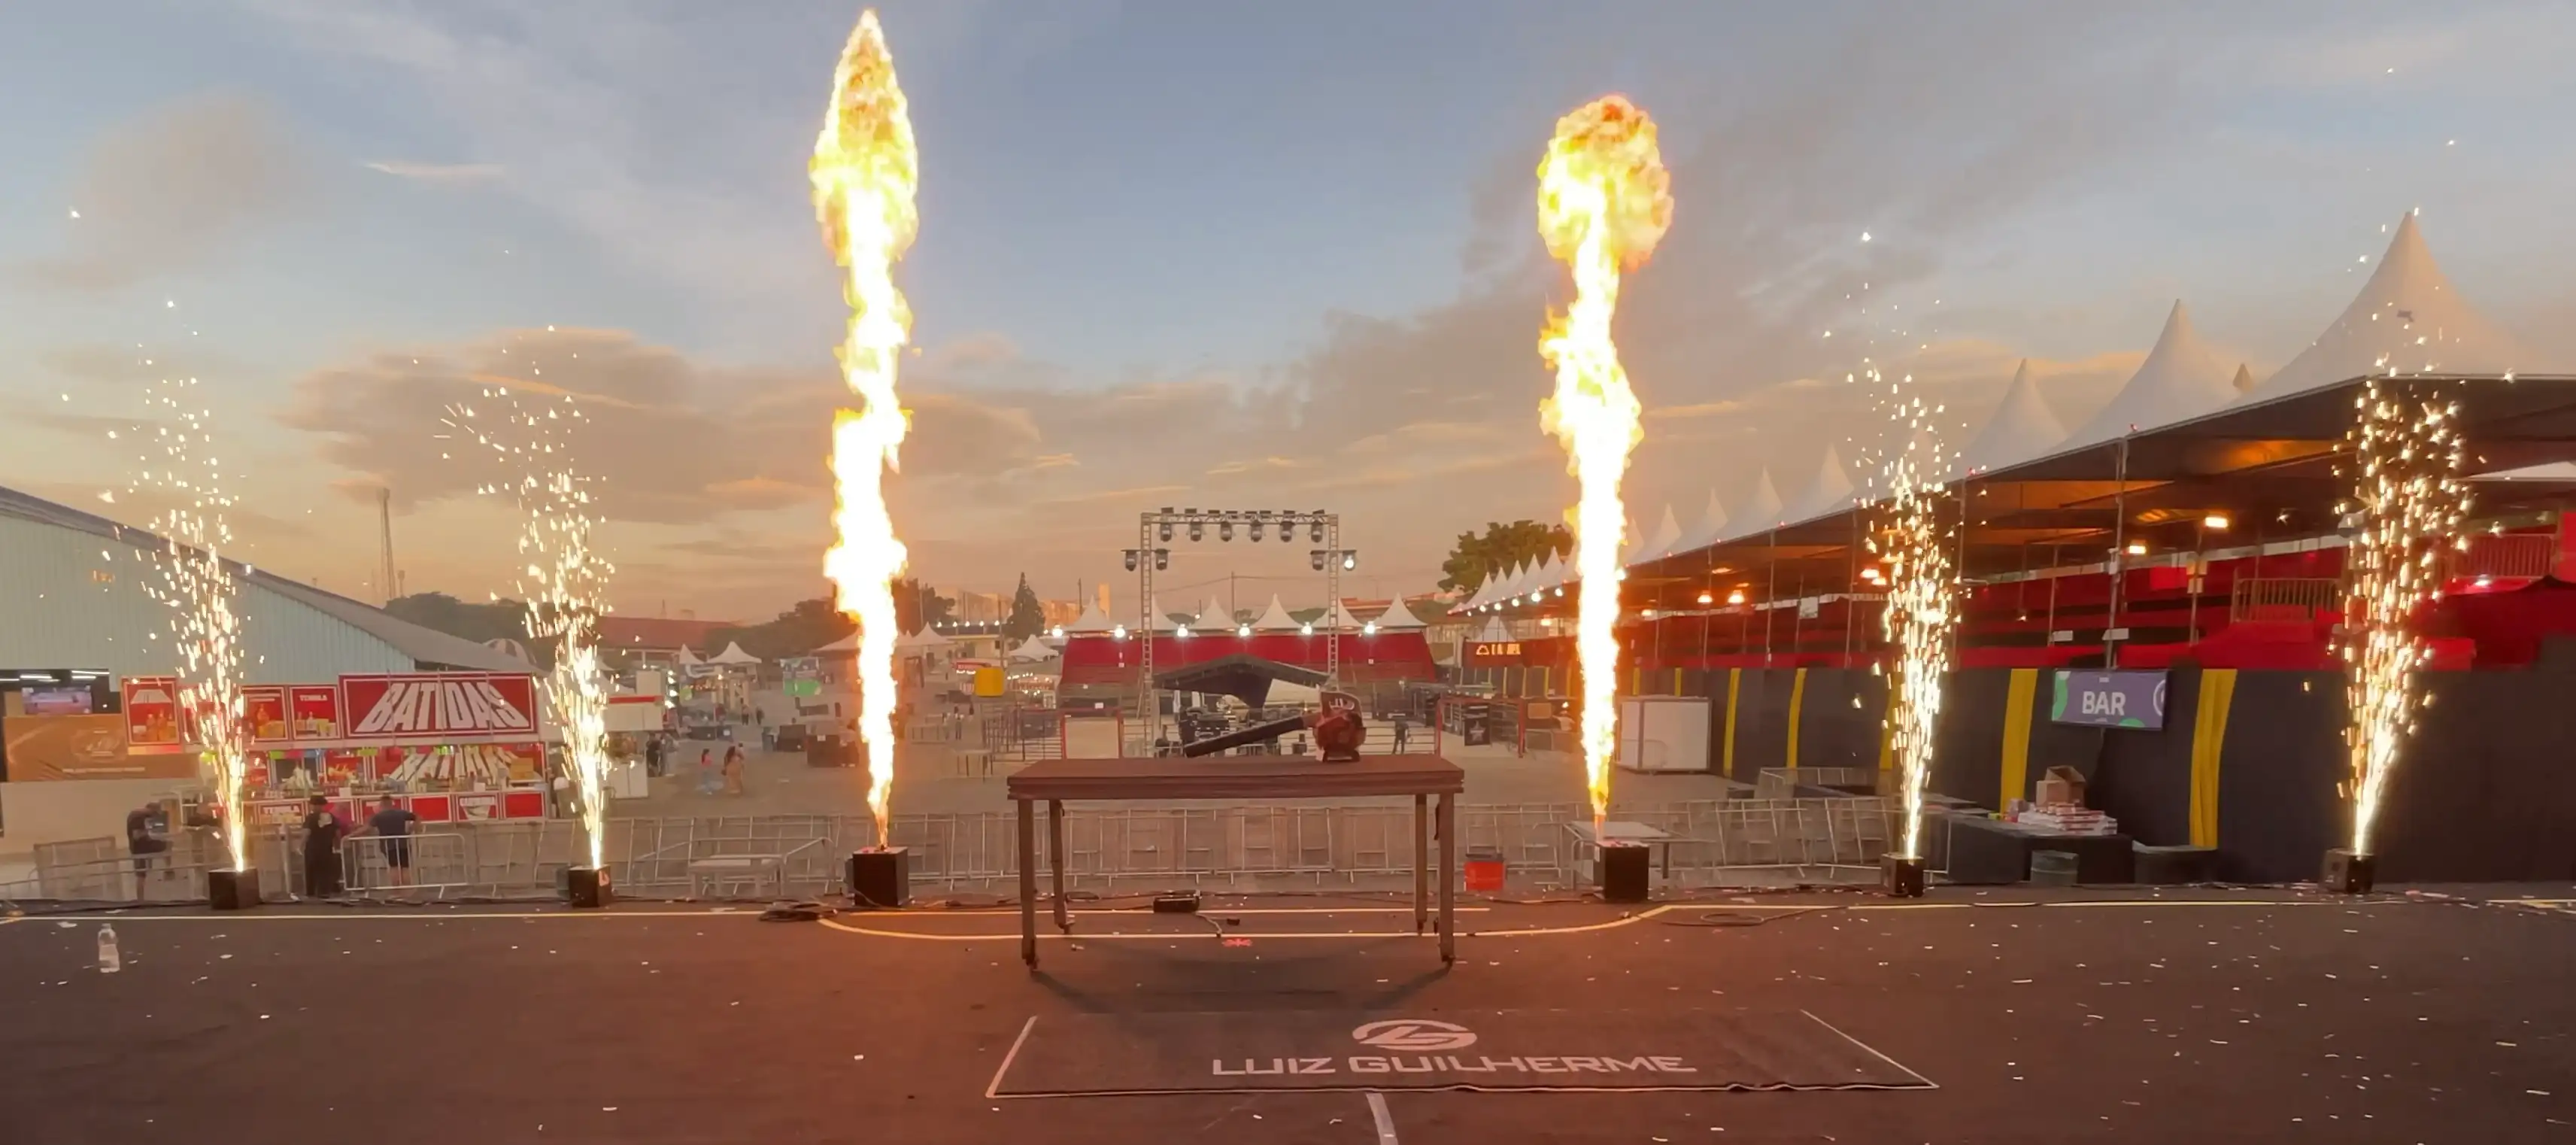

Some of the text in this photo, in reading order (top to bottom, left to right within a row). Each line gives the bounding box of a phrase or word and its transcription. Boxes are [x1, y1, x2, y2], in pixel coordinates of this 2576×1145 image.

[354, 682, 529, 732] BATIDAS
[2082, 691, 2126, 715] BAR
[1212, 1056, 1698, 1075] LUIZ GUILHERME
